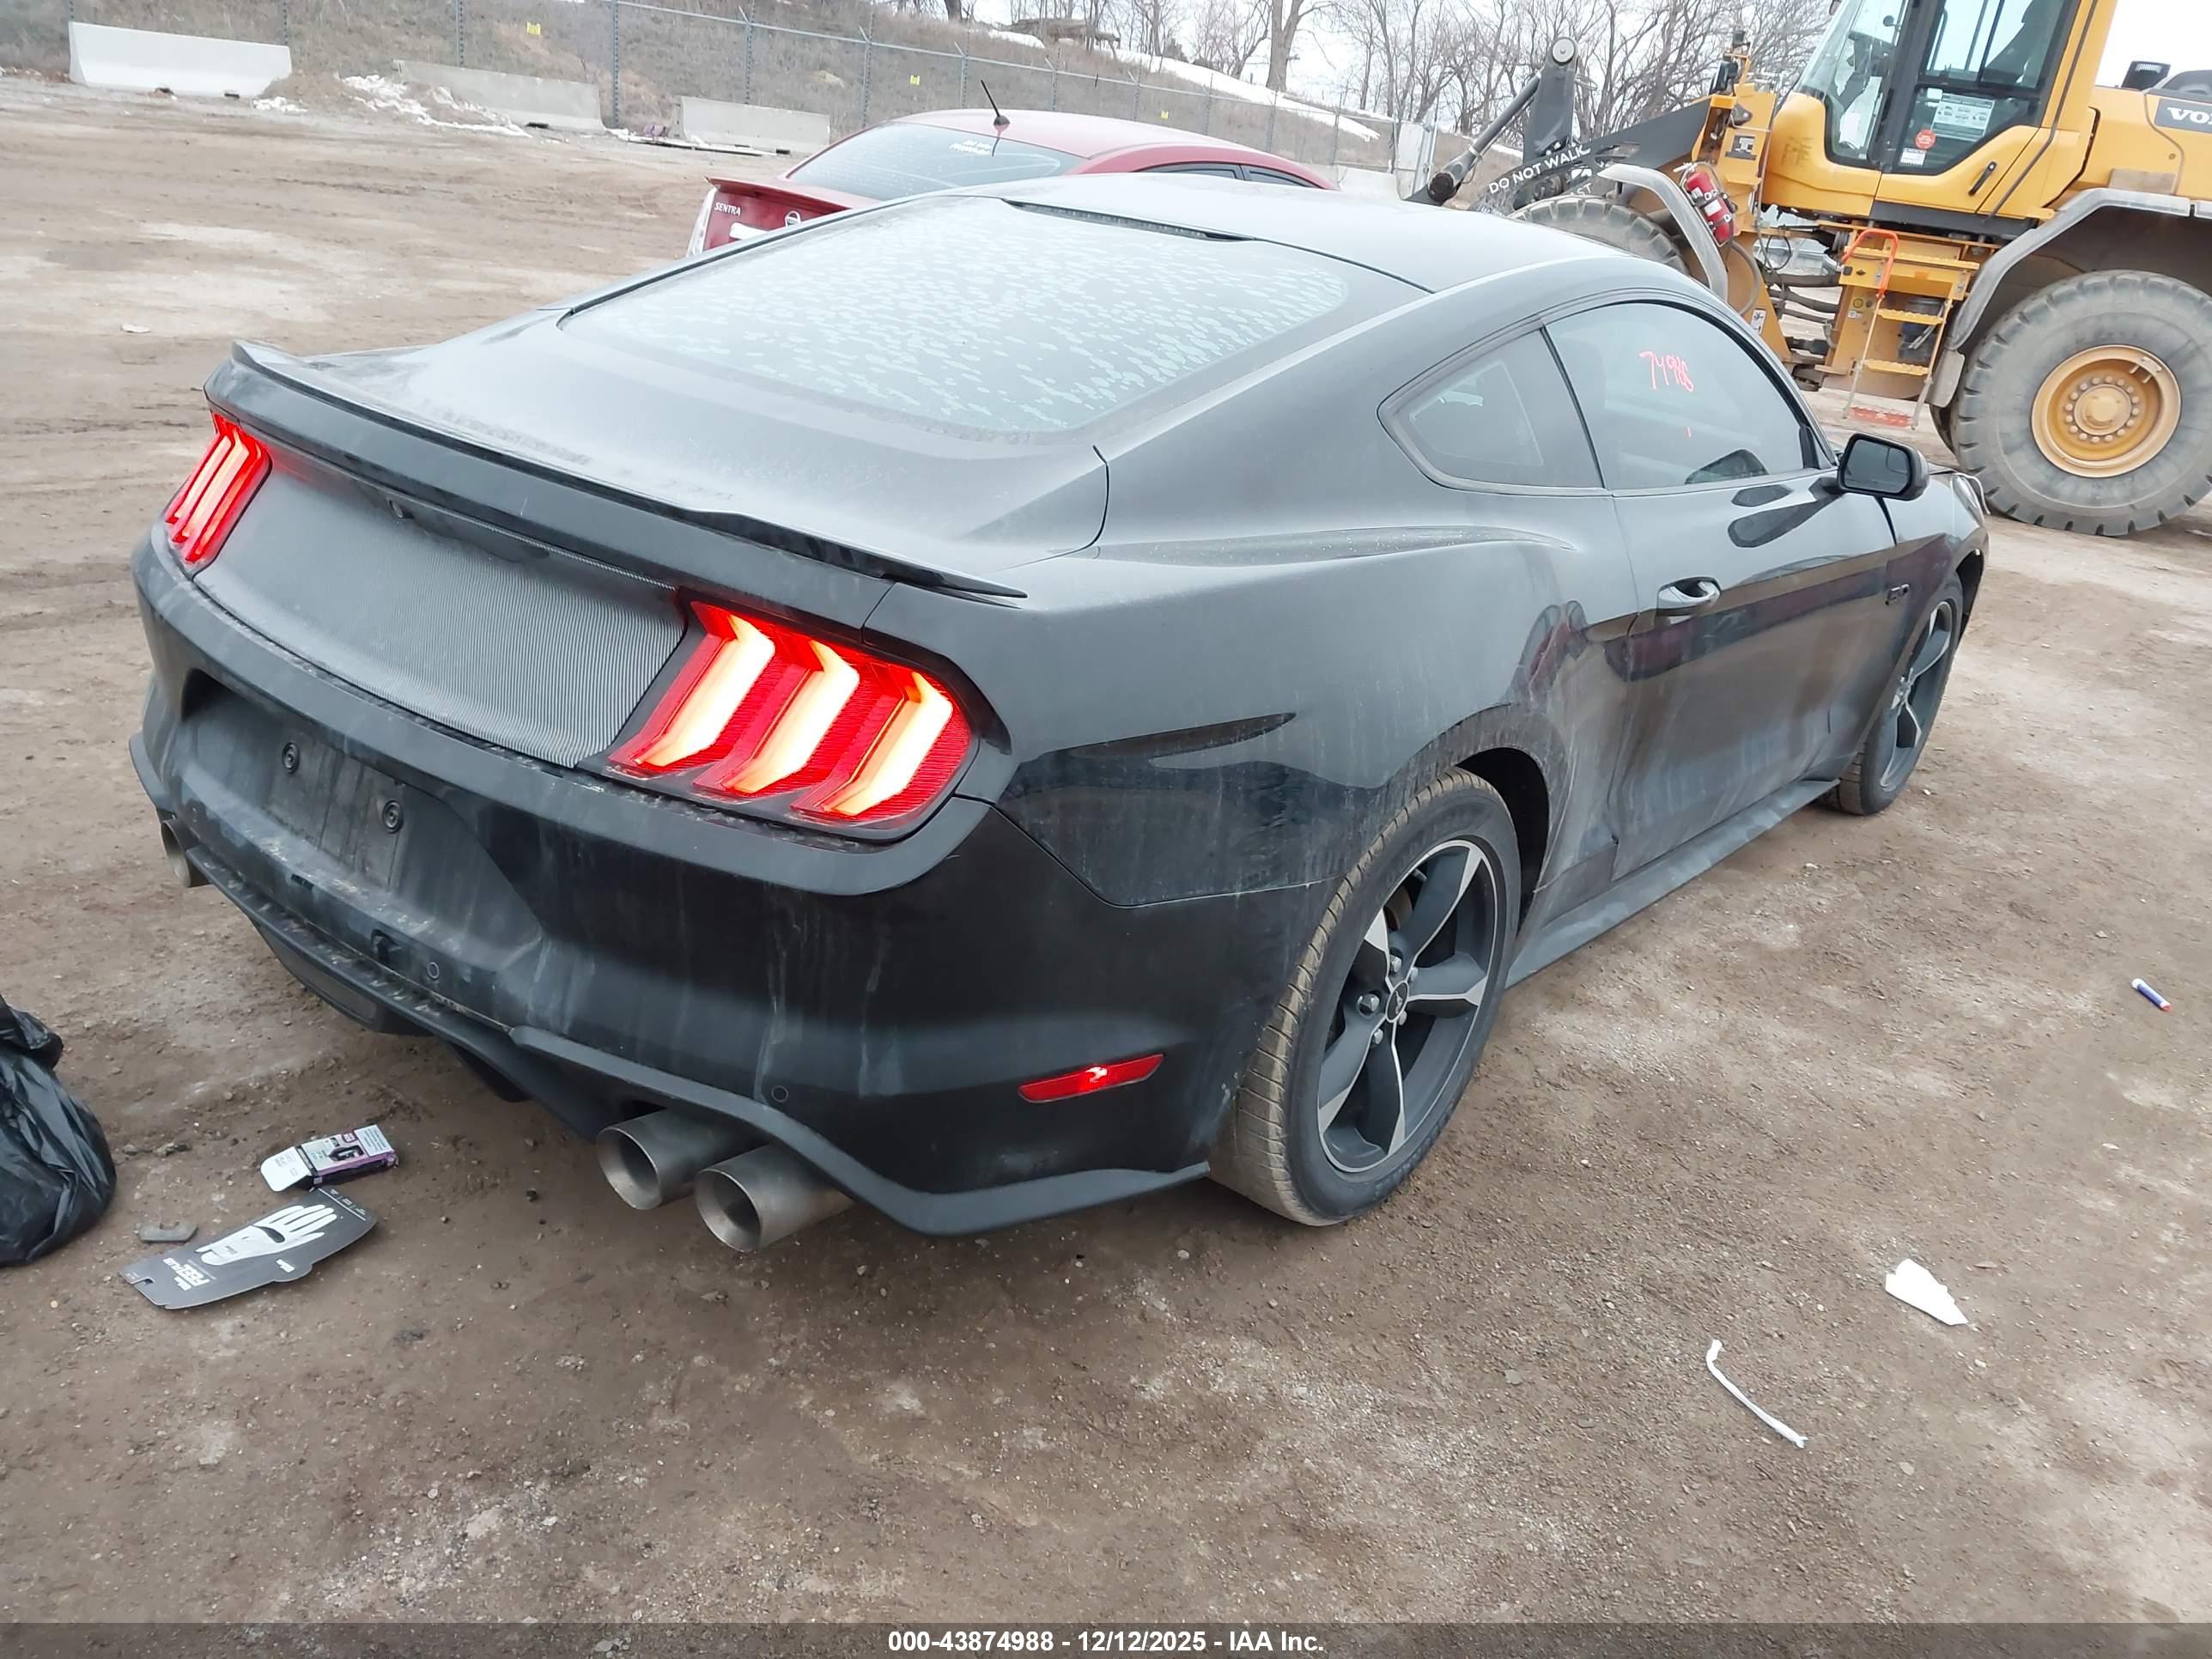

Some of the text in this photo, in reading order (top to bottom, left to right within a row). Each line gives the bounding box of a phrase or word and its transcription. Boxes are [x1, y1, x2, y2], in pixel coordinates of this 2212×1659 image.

[2166, 106, 2212, 125] VO
[1488, 143, 1592, 195] DO NOT WALK
[714, 201, 742, 217] SENTRA
